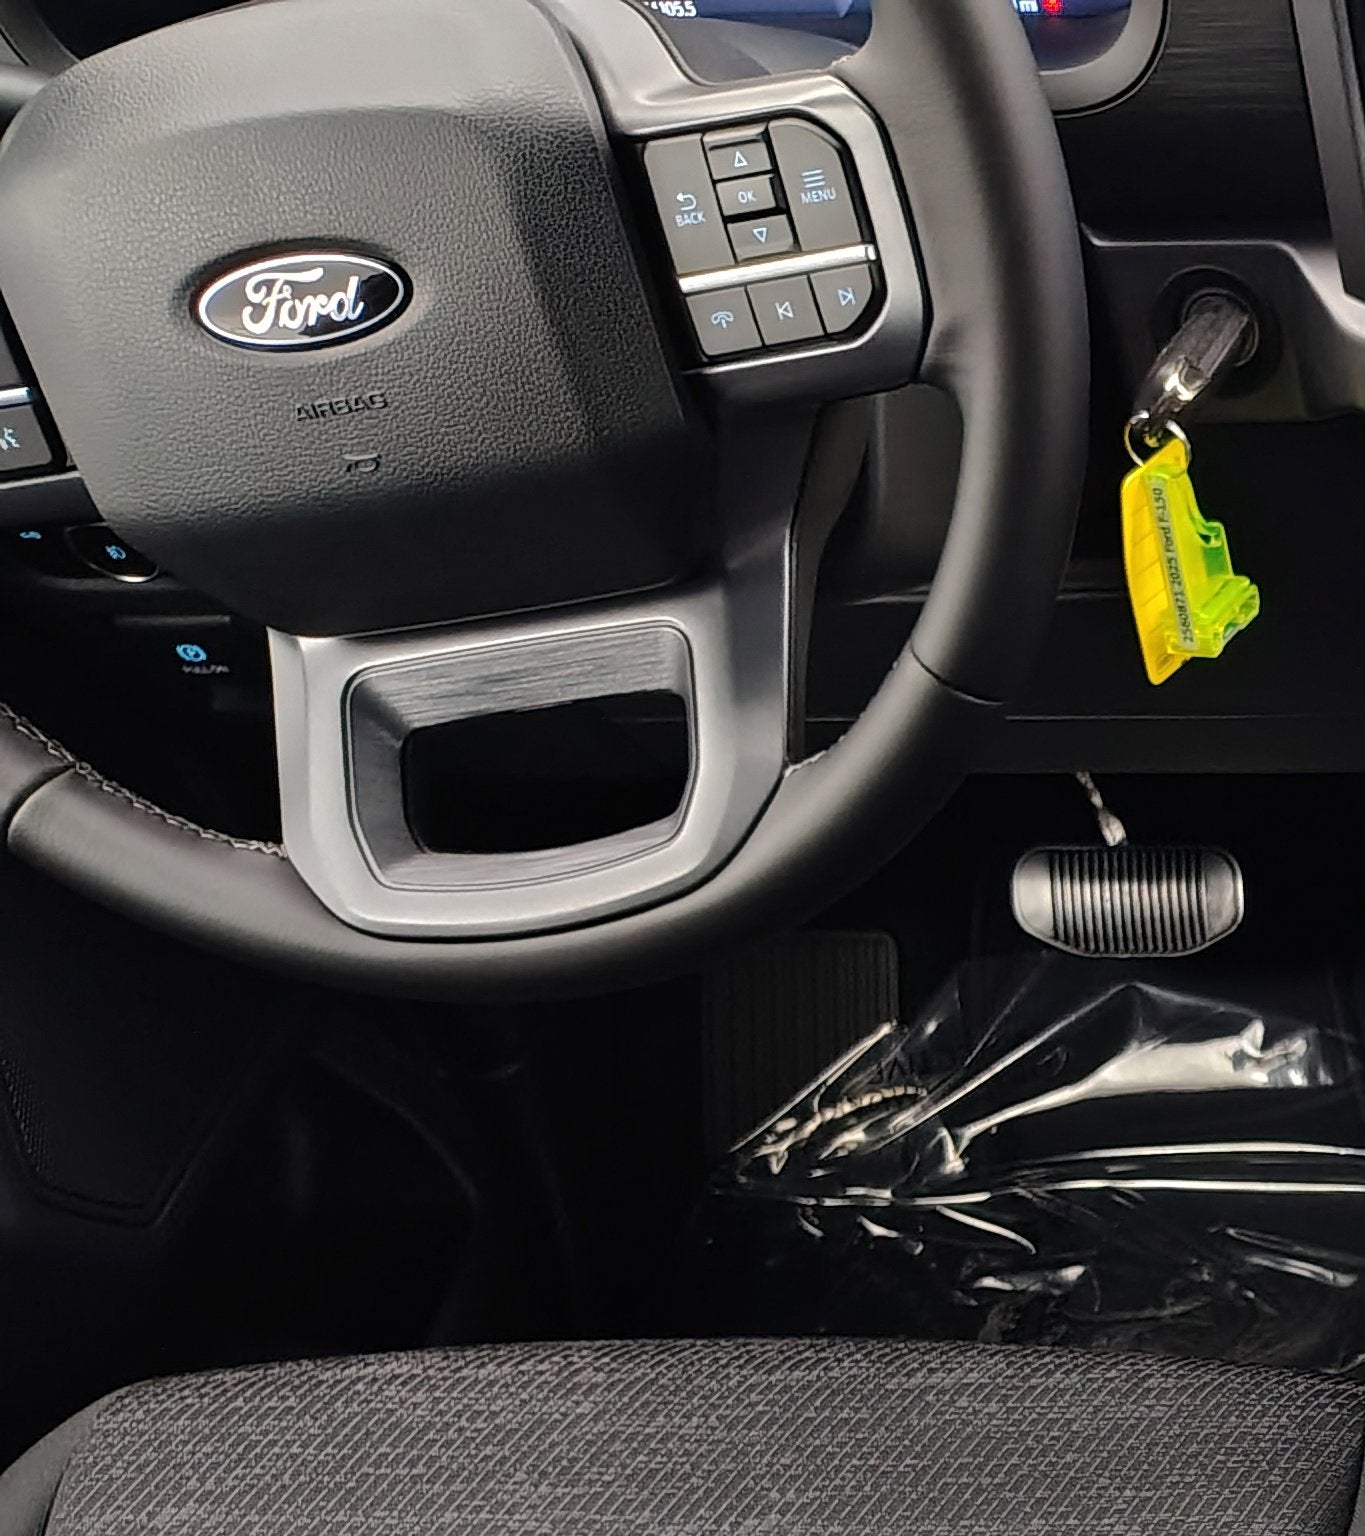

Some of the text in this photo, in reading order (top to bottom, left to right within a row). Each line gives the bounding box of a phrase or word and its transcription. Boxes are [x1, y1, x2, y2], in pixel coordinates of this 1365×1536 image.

[737, 191, 757, 203] OK
[801, 189, 837, 204] MENU
[675, 211, 706, 228] BACK
[242, 267, 364, 334] Ford
[296, 391, 388, 421] AIRBAG
[1152, 487, 1169, 523] F-150
[1161, 527, 1175, 552] Ford
[1167, 559, 1182, 588] 2025
